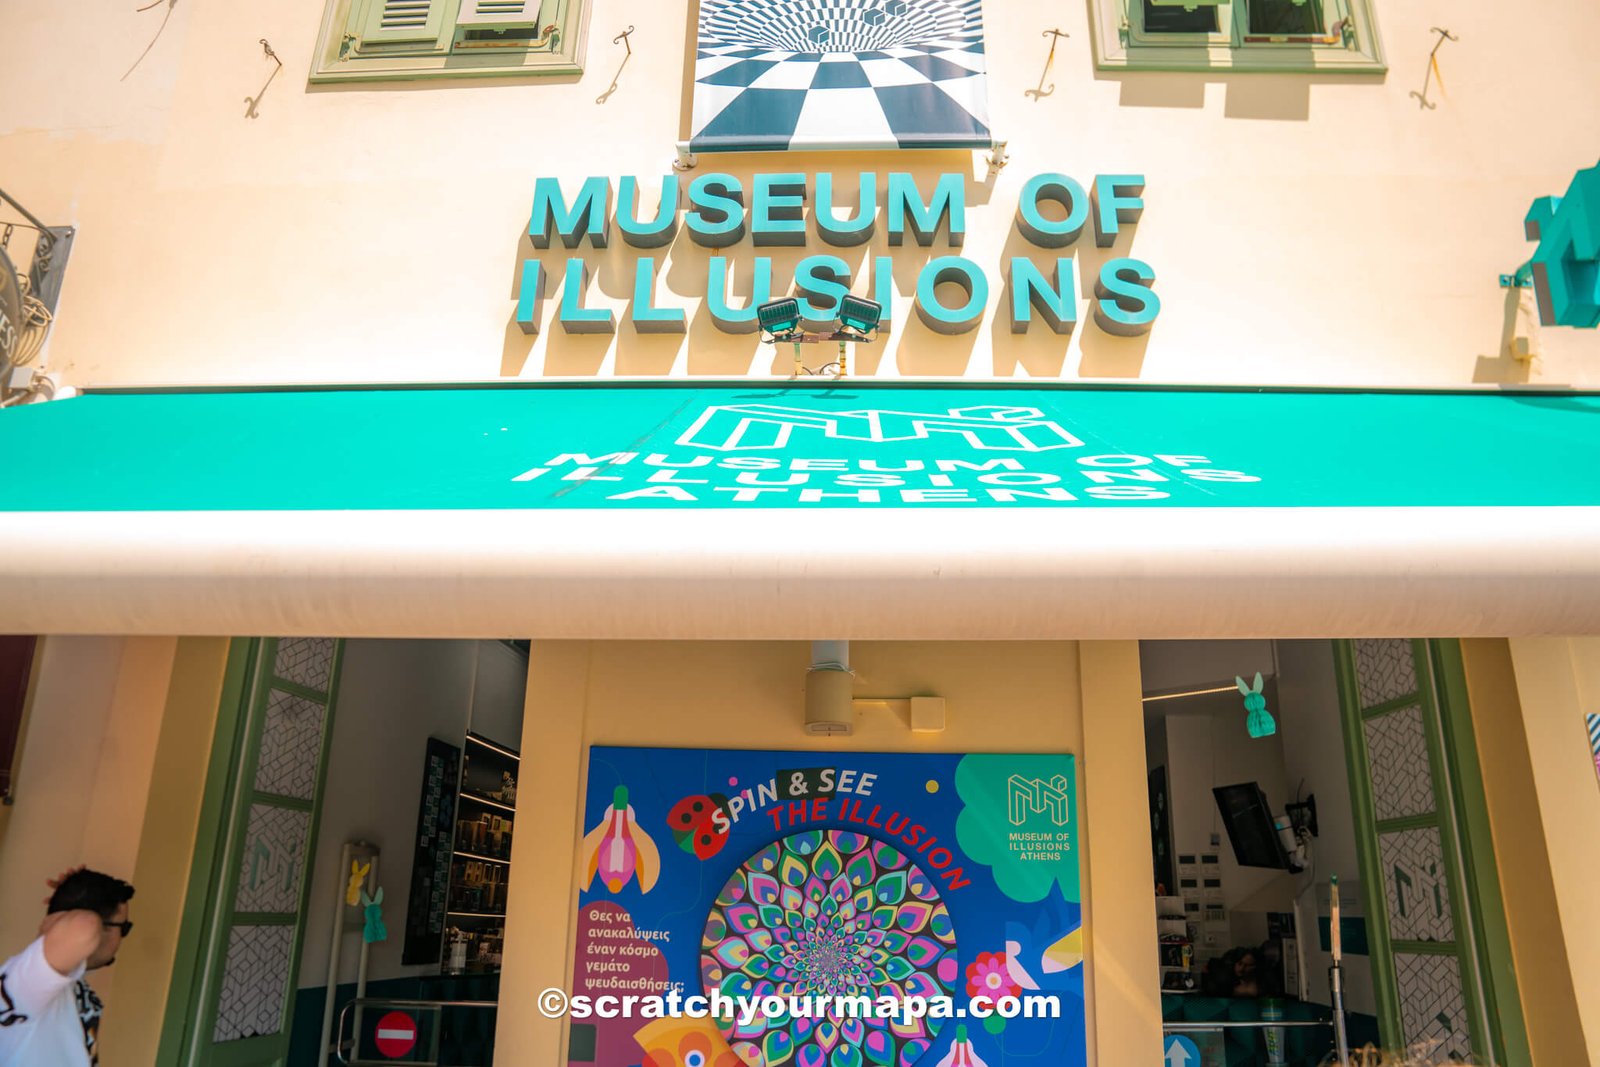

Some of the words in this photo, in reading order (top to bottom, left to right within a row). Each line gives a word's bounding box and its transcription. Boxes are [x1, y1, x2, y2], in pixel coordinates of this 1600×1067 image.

[528, 171, 966, 247] MUSEUM
[1016, 172, 1146, 247] OF
[516, 254, 1161, 335] ILLUSIONS
[543, 451, 1026, 471] MUSEUM
[1076, 454, 1213, 467] OF
[511, 467, 1262, 487] ILLUSIONS
[605, 485, 1171, 503] ATHENS
[711, 778, 778, 834] SPIN
[788, 771, 808, 796] &
[818, 769, 878, 796] SEE
[766, 797, 829, 832] THE
[838, 798, 971, 891] ILLUSION
[1009, 832, 1052, 841] MUSEUM
[1056, 832, 1070, 841] OF
[1009, 842, 1070, 851] ILLUSIONS
[1020, 852, 1061, 861] ATHENS
[589, 909, 613, 922] Θες
[615, 912, 631, 922] να
[588, 926, 670, 942] ανακαλύψεις
[586, 942, 616, 955] έναν
[619, 943, 659, 958] κόσμο
[585, 958, 630, 973] γεμάτο
[584, 976, 685, 993] ψευδαισθήσεις;
